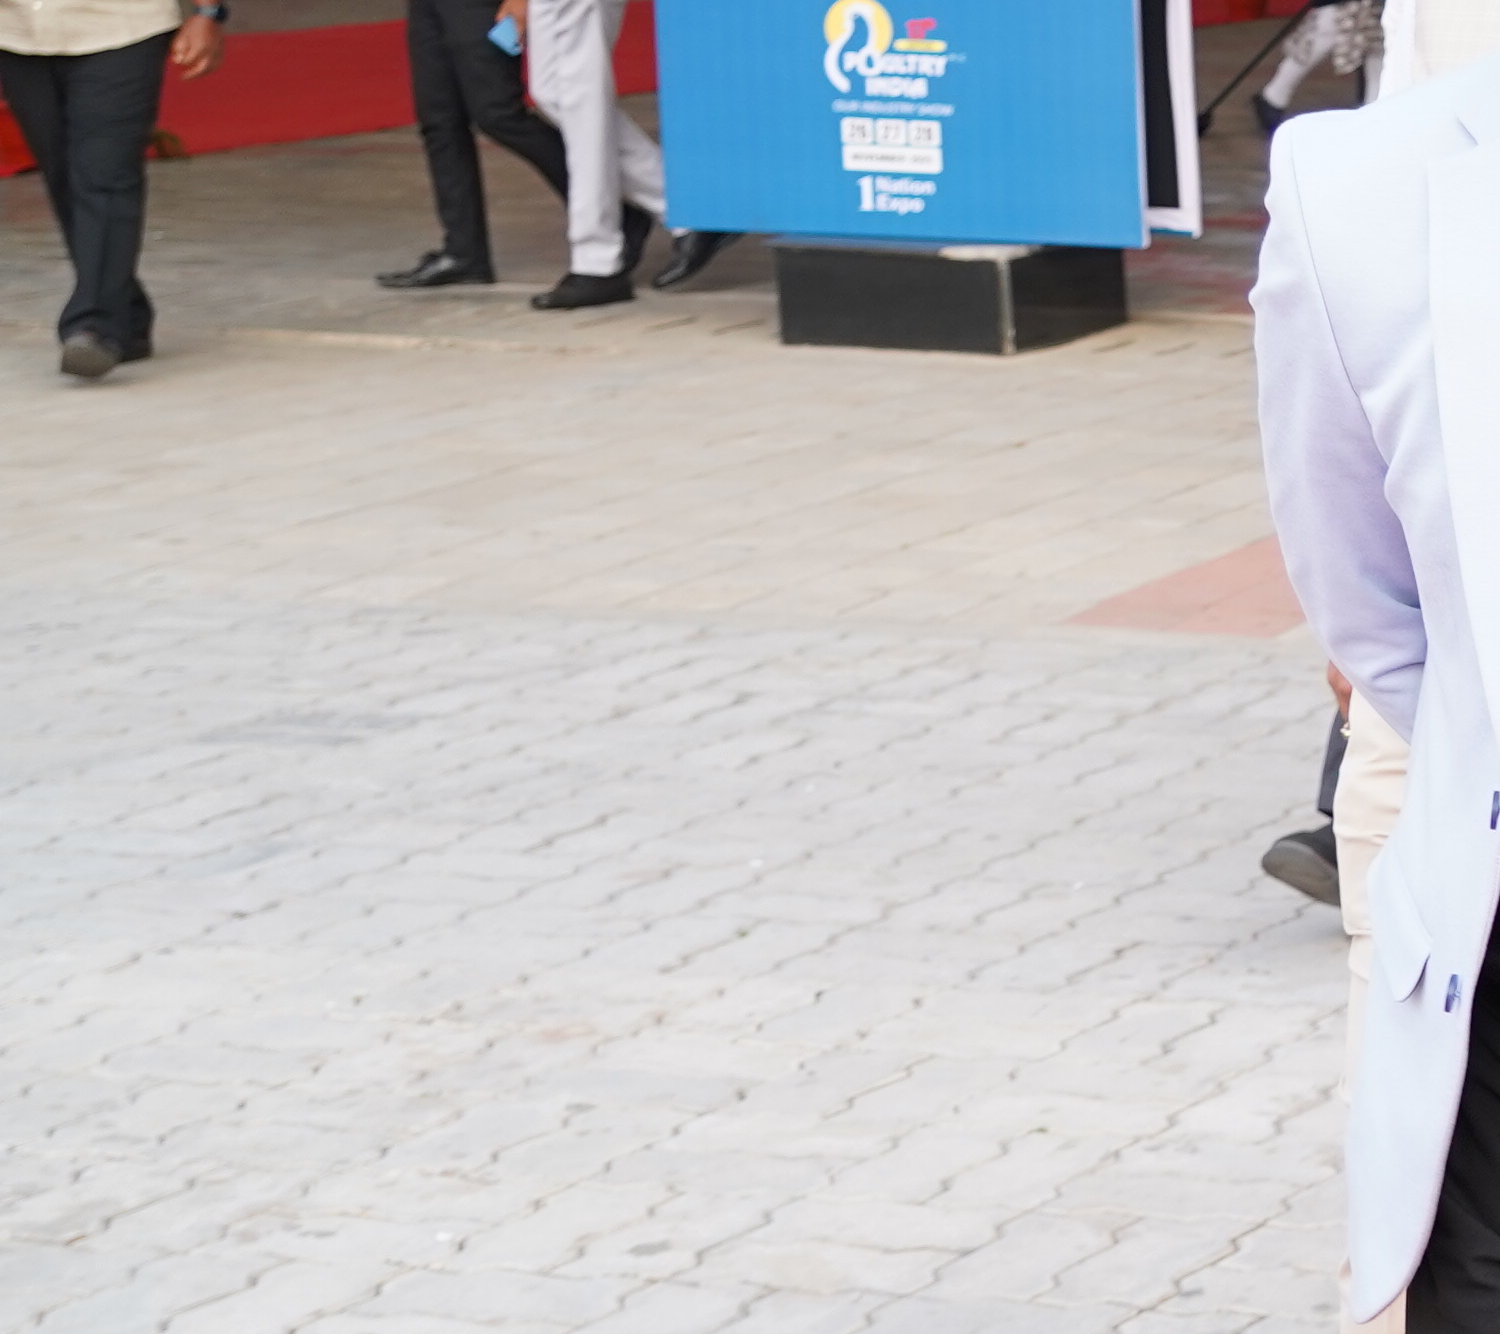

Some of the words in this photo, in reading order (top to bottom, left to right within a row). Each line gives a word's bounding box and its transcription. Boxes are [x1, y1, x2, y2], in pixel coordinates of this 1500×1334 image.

[857, 175, 875, 212] 1
[875, 176, 937, 197] Nation
[875, 193, 926, 215] Expo
